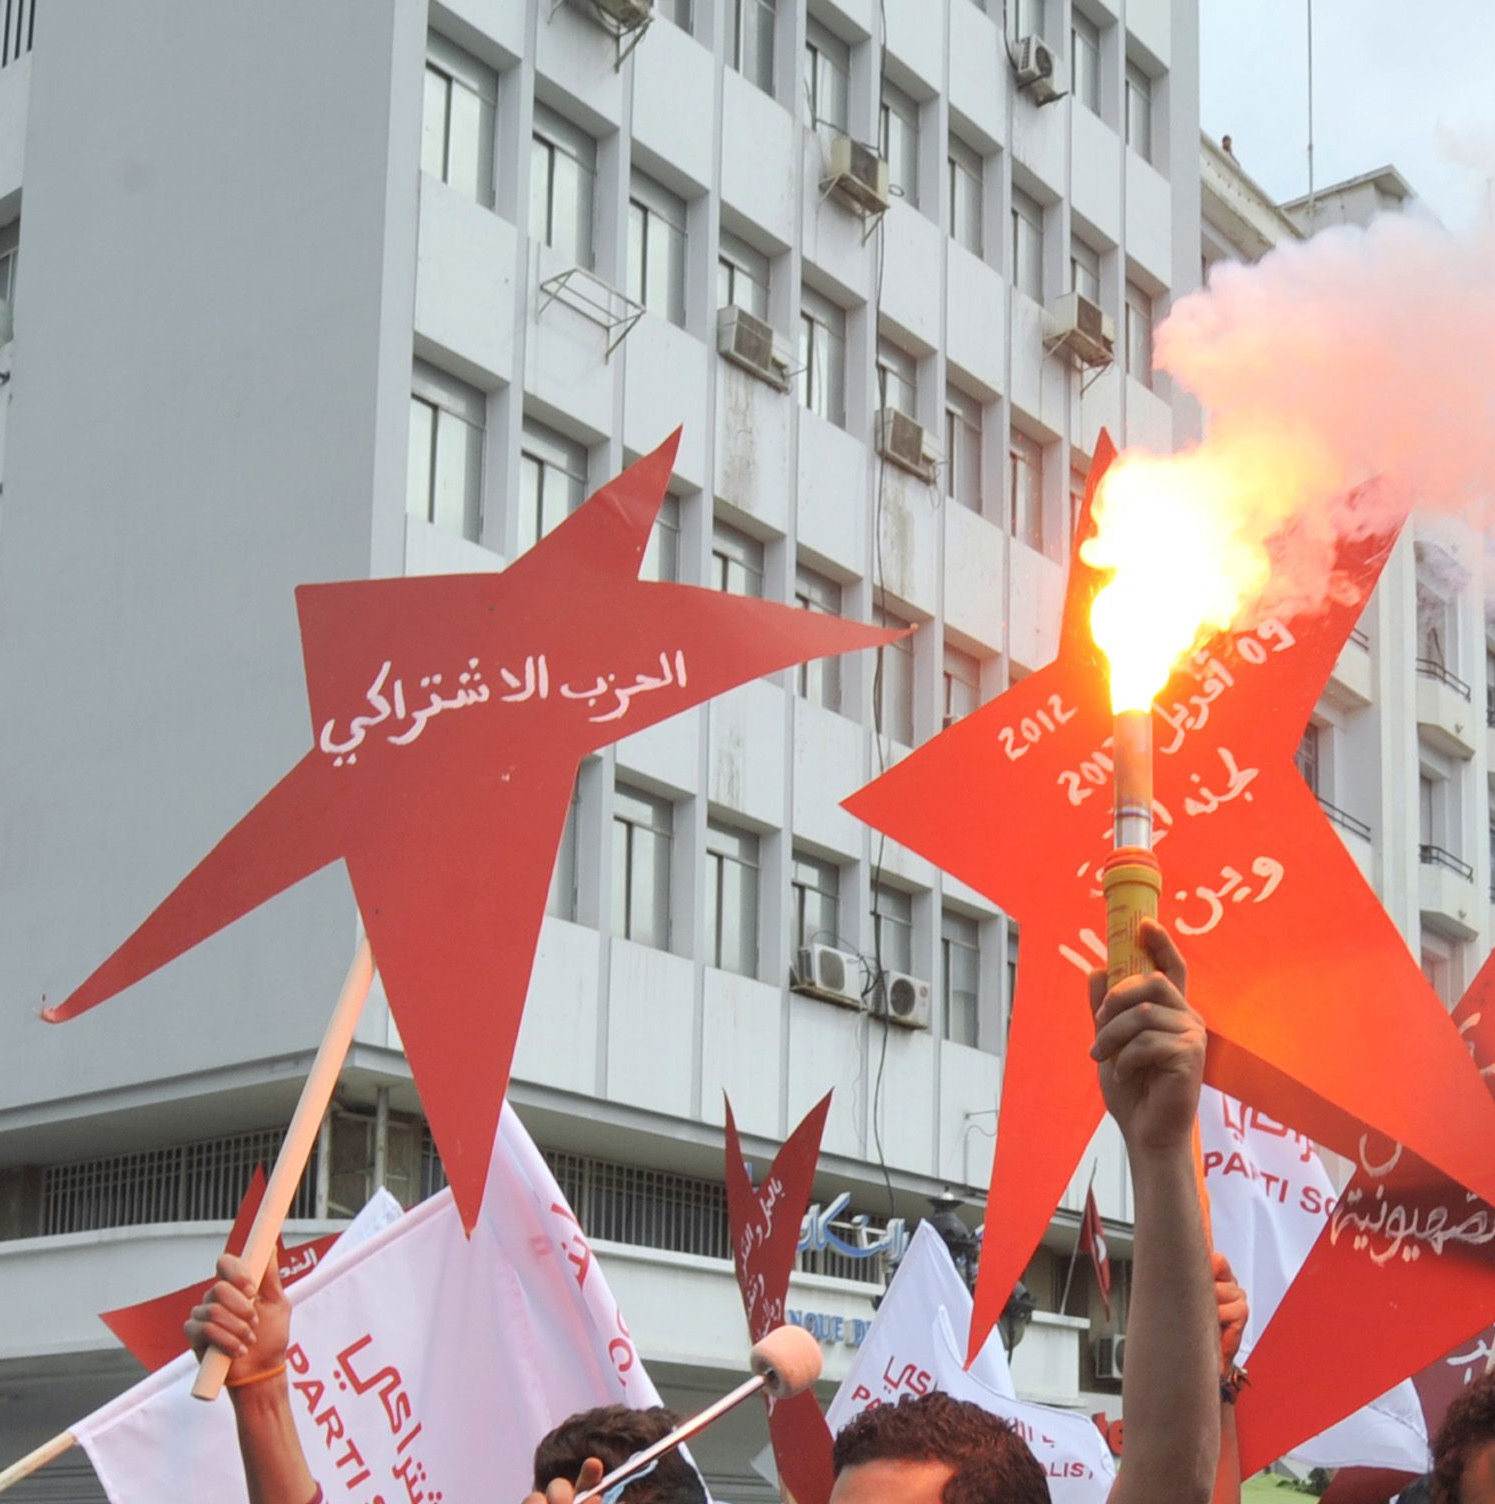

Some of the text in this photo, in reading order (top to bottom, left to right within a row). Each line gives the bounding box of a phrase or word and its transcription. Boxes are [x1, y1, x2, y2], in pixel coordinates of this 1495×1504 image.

[560, 650, 688, 723] الحزب
[998, 693, 1078, 761] 2012
[1056, 735, 1114, 806] 201
[285, 1342, 371, 1490] PARTI
